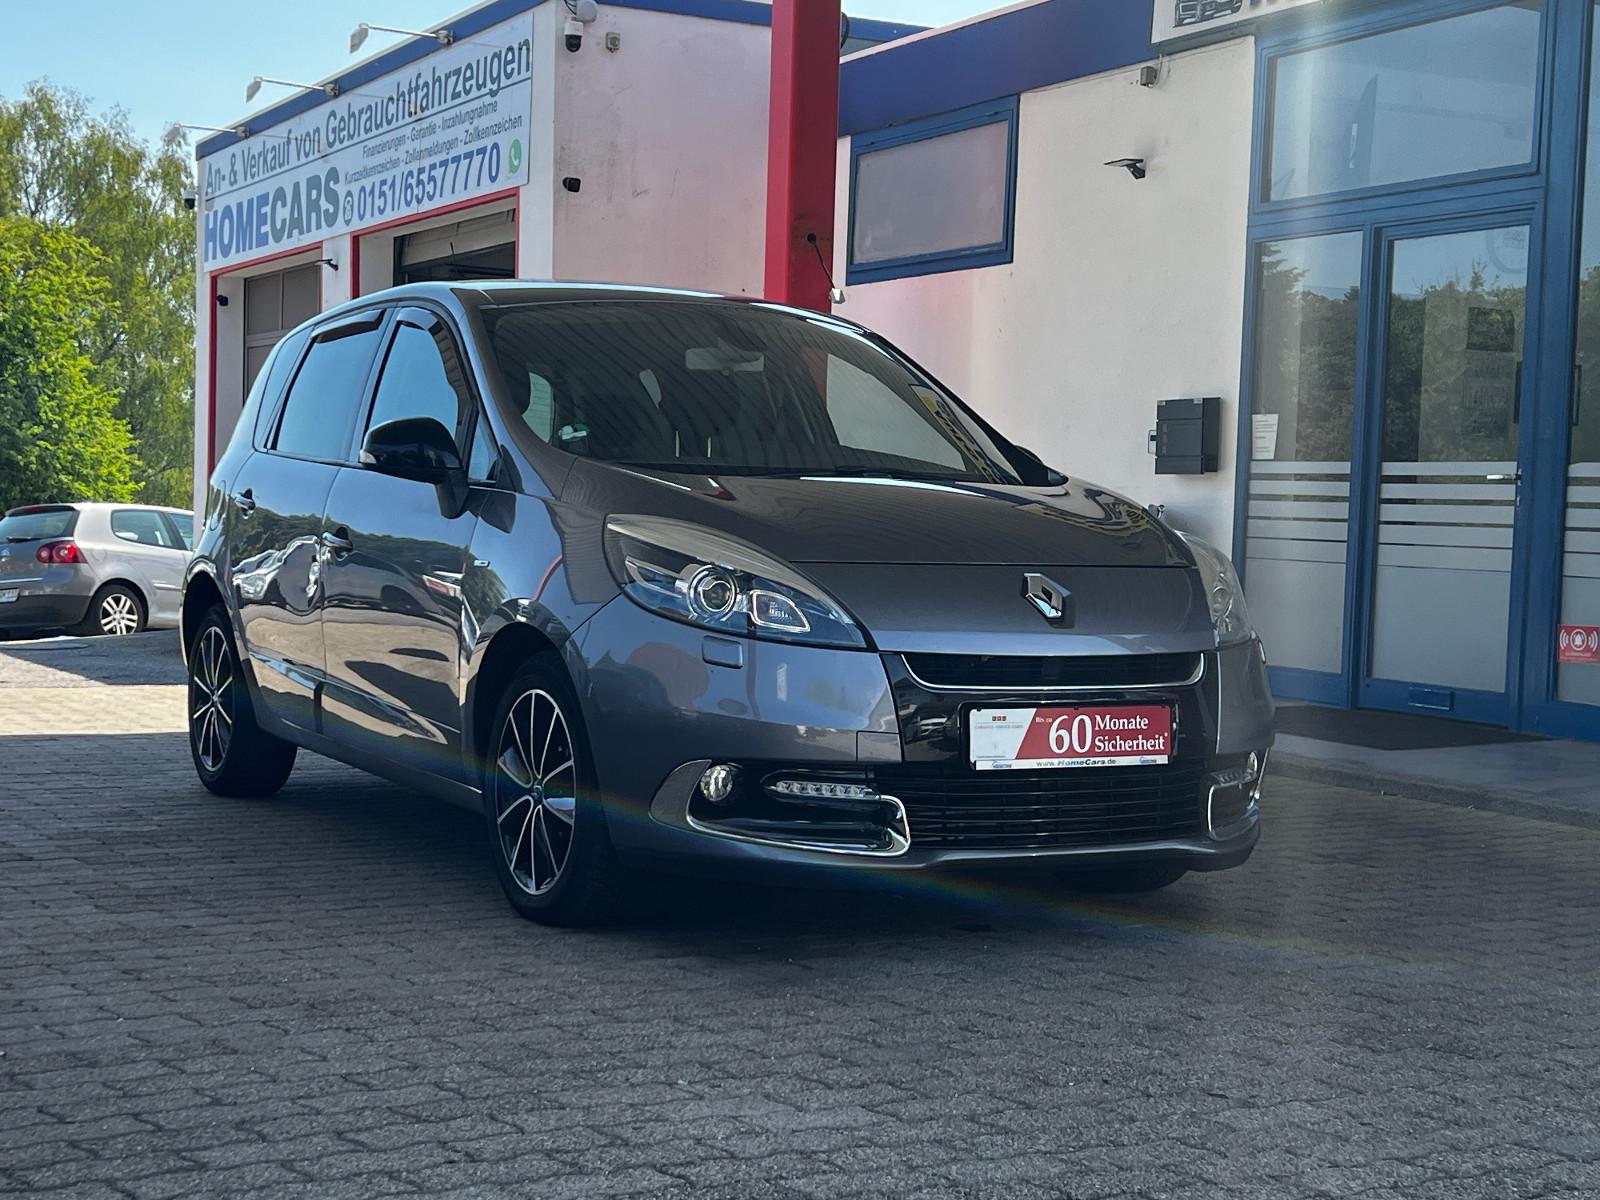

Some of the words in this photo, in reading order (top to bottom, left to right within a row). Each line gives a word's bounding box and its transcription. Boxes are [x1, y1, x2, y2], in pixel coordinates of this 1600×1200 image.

[205, 161, 226, 197] An-
[229, 152, 238, 188] &
[241, 128, 292, 182] Verkauf
[295, 126, 321, 161] von
[326, 38, 531, 149] Gebrauchtfahrzeugen
[204, 166, 341, 263] HOMECARS
[358, 142, 501, 222] 0151/65577770
[1049, 714, 1093, 754] 60
[1094, 714, 1149, 731] Monate
